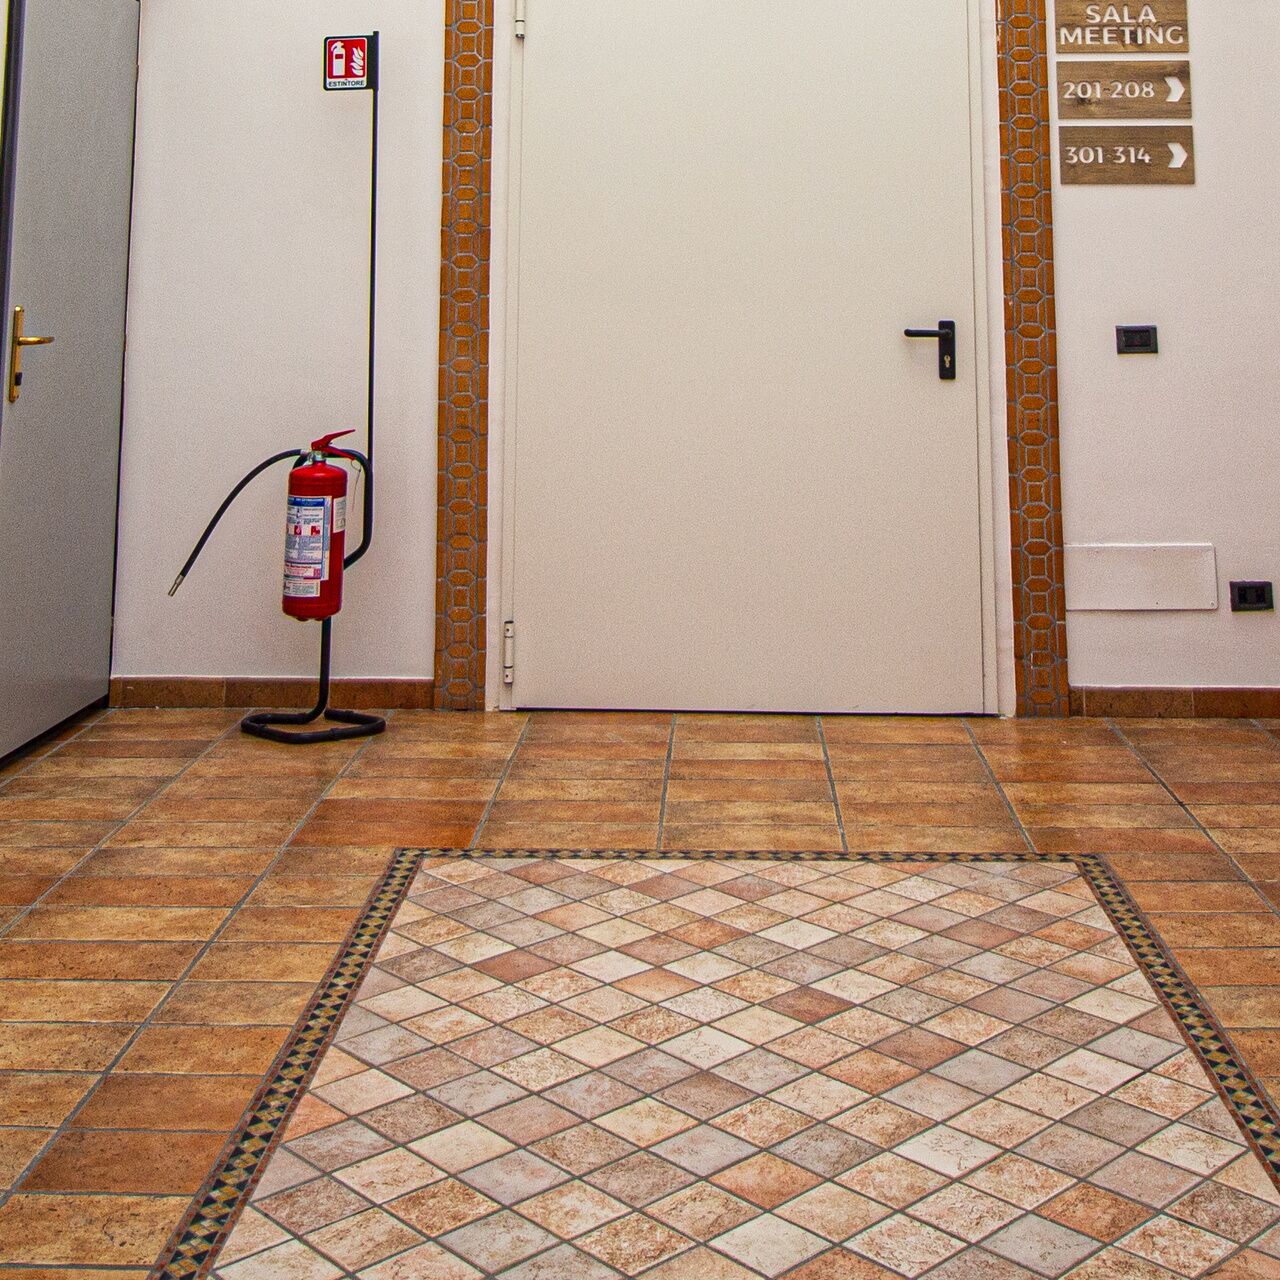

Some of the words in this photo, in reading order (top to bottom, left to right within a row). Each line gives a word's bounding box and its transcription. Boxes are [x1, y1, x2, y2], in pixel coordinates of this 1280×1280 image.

[1086, 4, 1157, 24] SALA
[1060, 26, 1185, 45] MEETING
[1063, 81, 1155, 99] 201-208
[1065, 146, 1151, 164] 301-314
